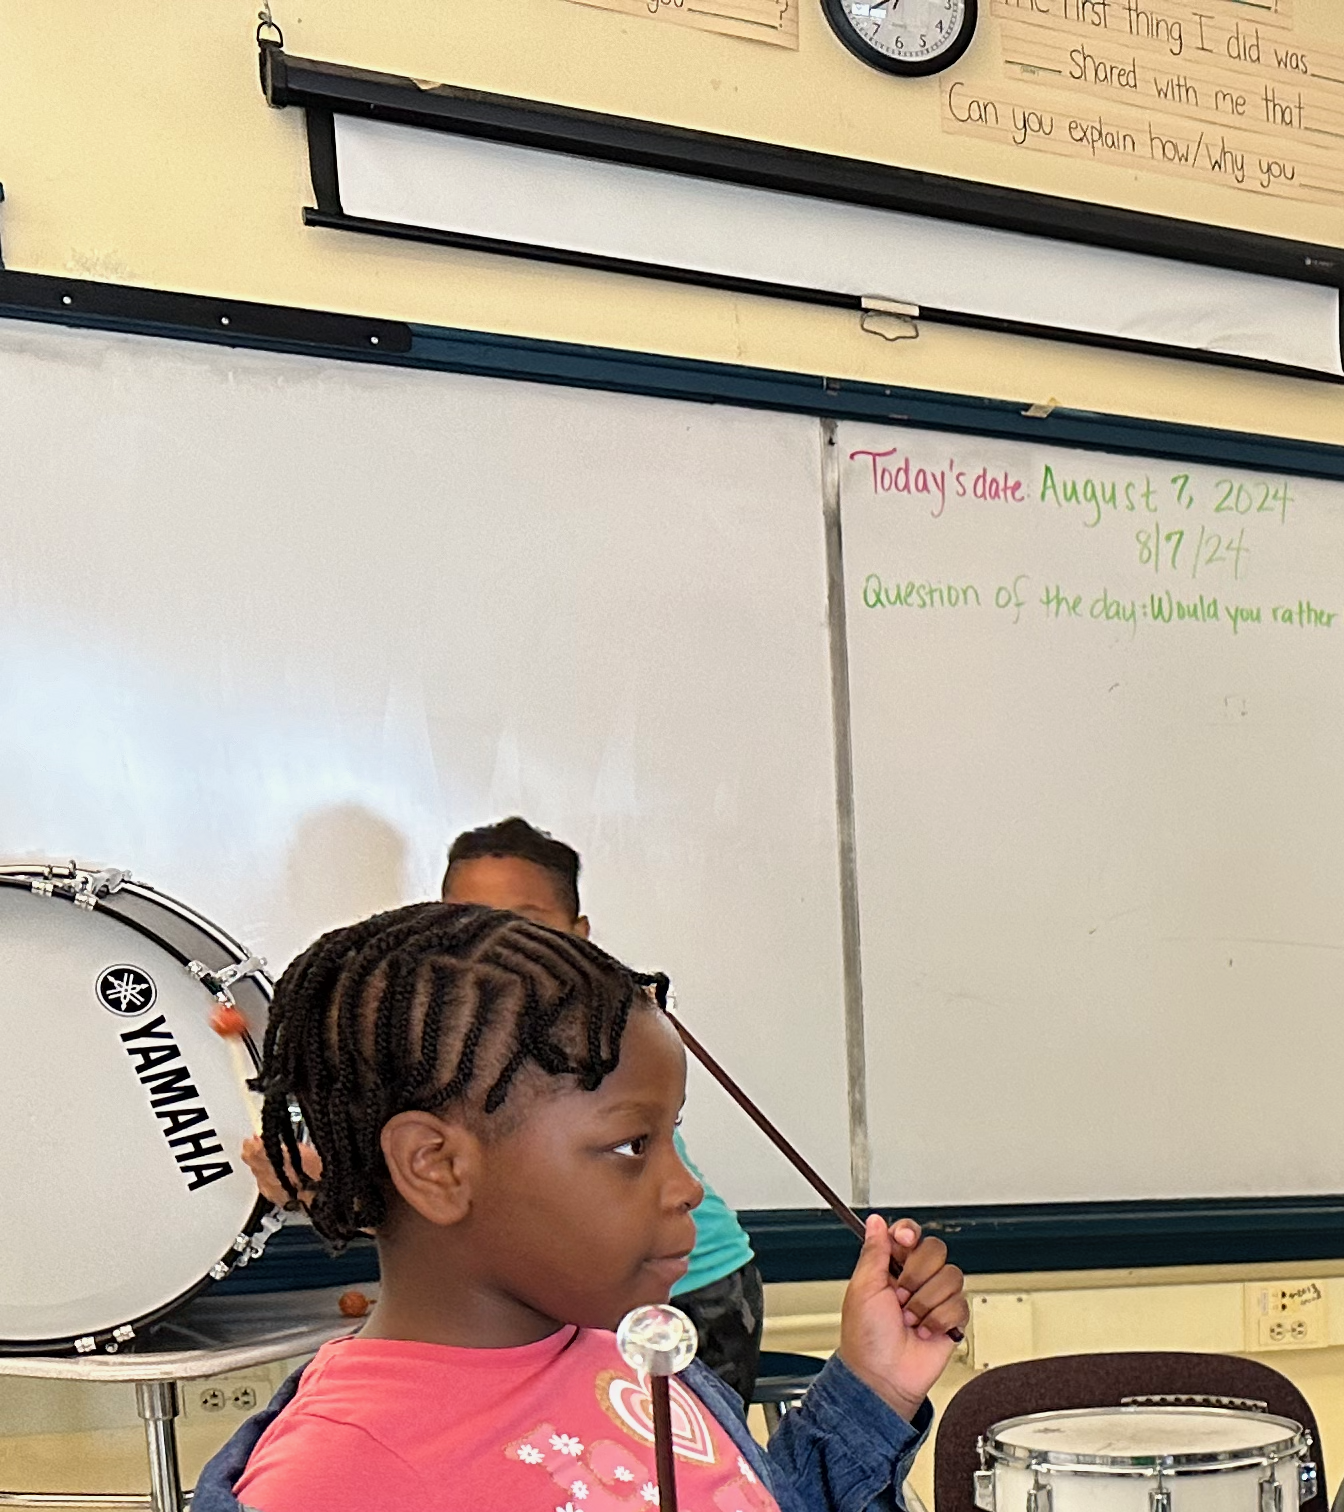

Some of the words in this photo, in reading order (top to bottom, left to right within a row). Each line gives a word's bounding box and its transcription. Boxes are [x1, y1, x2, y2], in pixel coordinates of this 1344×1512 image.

[1126, 0, 1184, 55] thing
[1191, 12, 1215, 52] I
[1227, 22, 1260, 64] did
[1274, 46, 1308, 75] was
[948, 82, 999, 126] Can
[1011, 105, 1055, 144] you
[1068, 117, 1136, 156] explain
[1257, 155, 1297, 189] you
[1153, 74, 1199, 107] with
[1215, 87, 1247, 116] me
[1262, 84, 1308, 129] that
[849, 446, 969, 520] Today's
[1040, 463, 1158, 528] August
[1214, 478, 1294, 525] 2024
[863, 573, 982, 610] Question
[995, 574, 1029, 625] of
[1040, 583, 1084, 619] the
[1226, 605, 1265, 636] you
[1272, 599, 1337, 630] rather
[120, 1015, 234, 1192] YAMAHA
